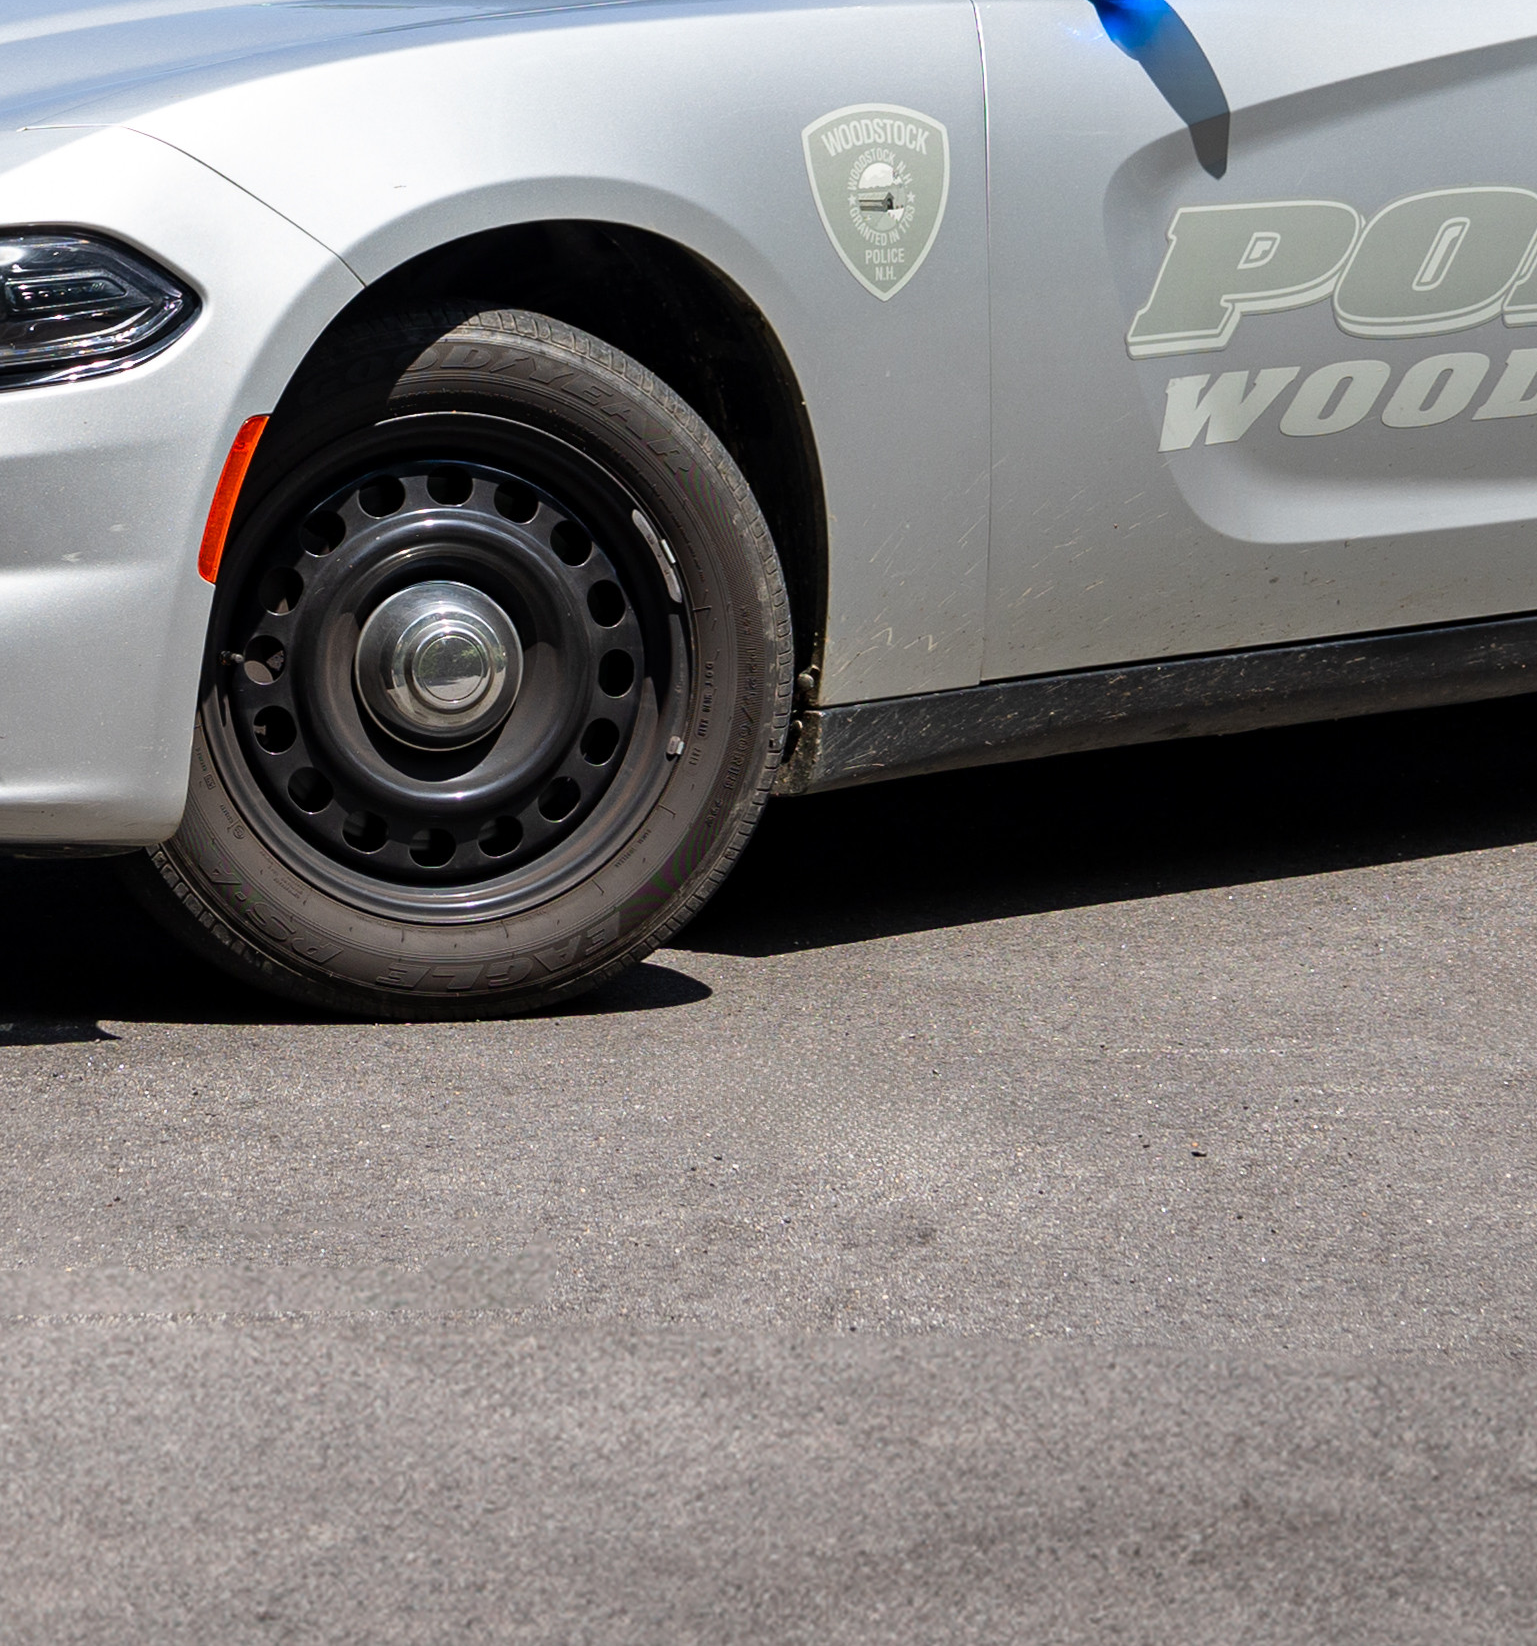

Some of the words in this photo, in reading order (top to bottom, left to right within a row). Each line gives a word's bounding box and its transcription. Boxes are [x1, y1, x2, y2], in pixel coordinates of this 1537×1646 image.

[820, 118, 930, 157] WOODSTOCK
[849, 206, 887, 246] GRANTED
[889, 230, 901, 244] IN
[899, 204, 916, 234] 1763
[865, 248, 905, 265] POLICE
[875, 266, 897, 281] N.H.
[375, 907, 621, 992] EAGLE
